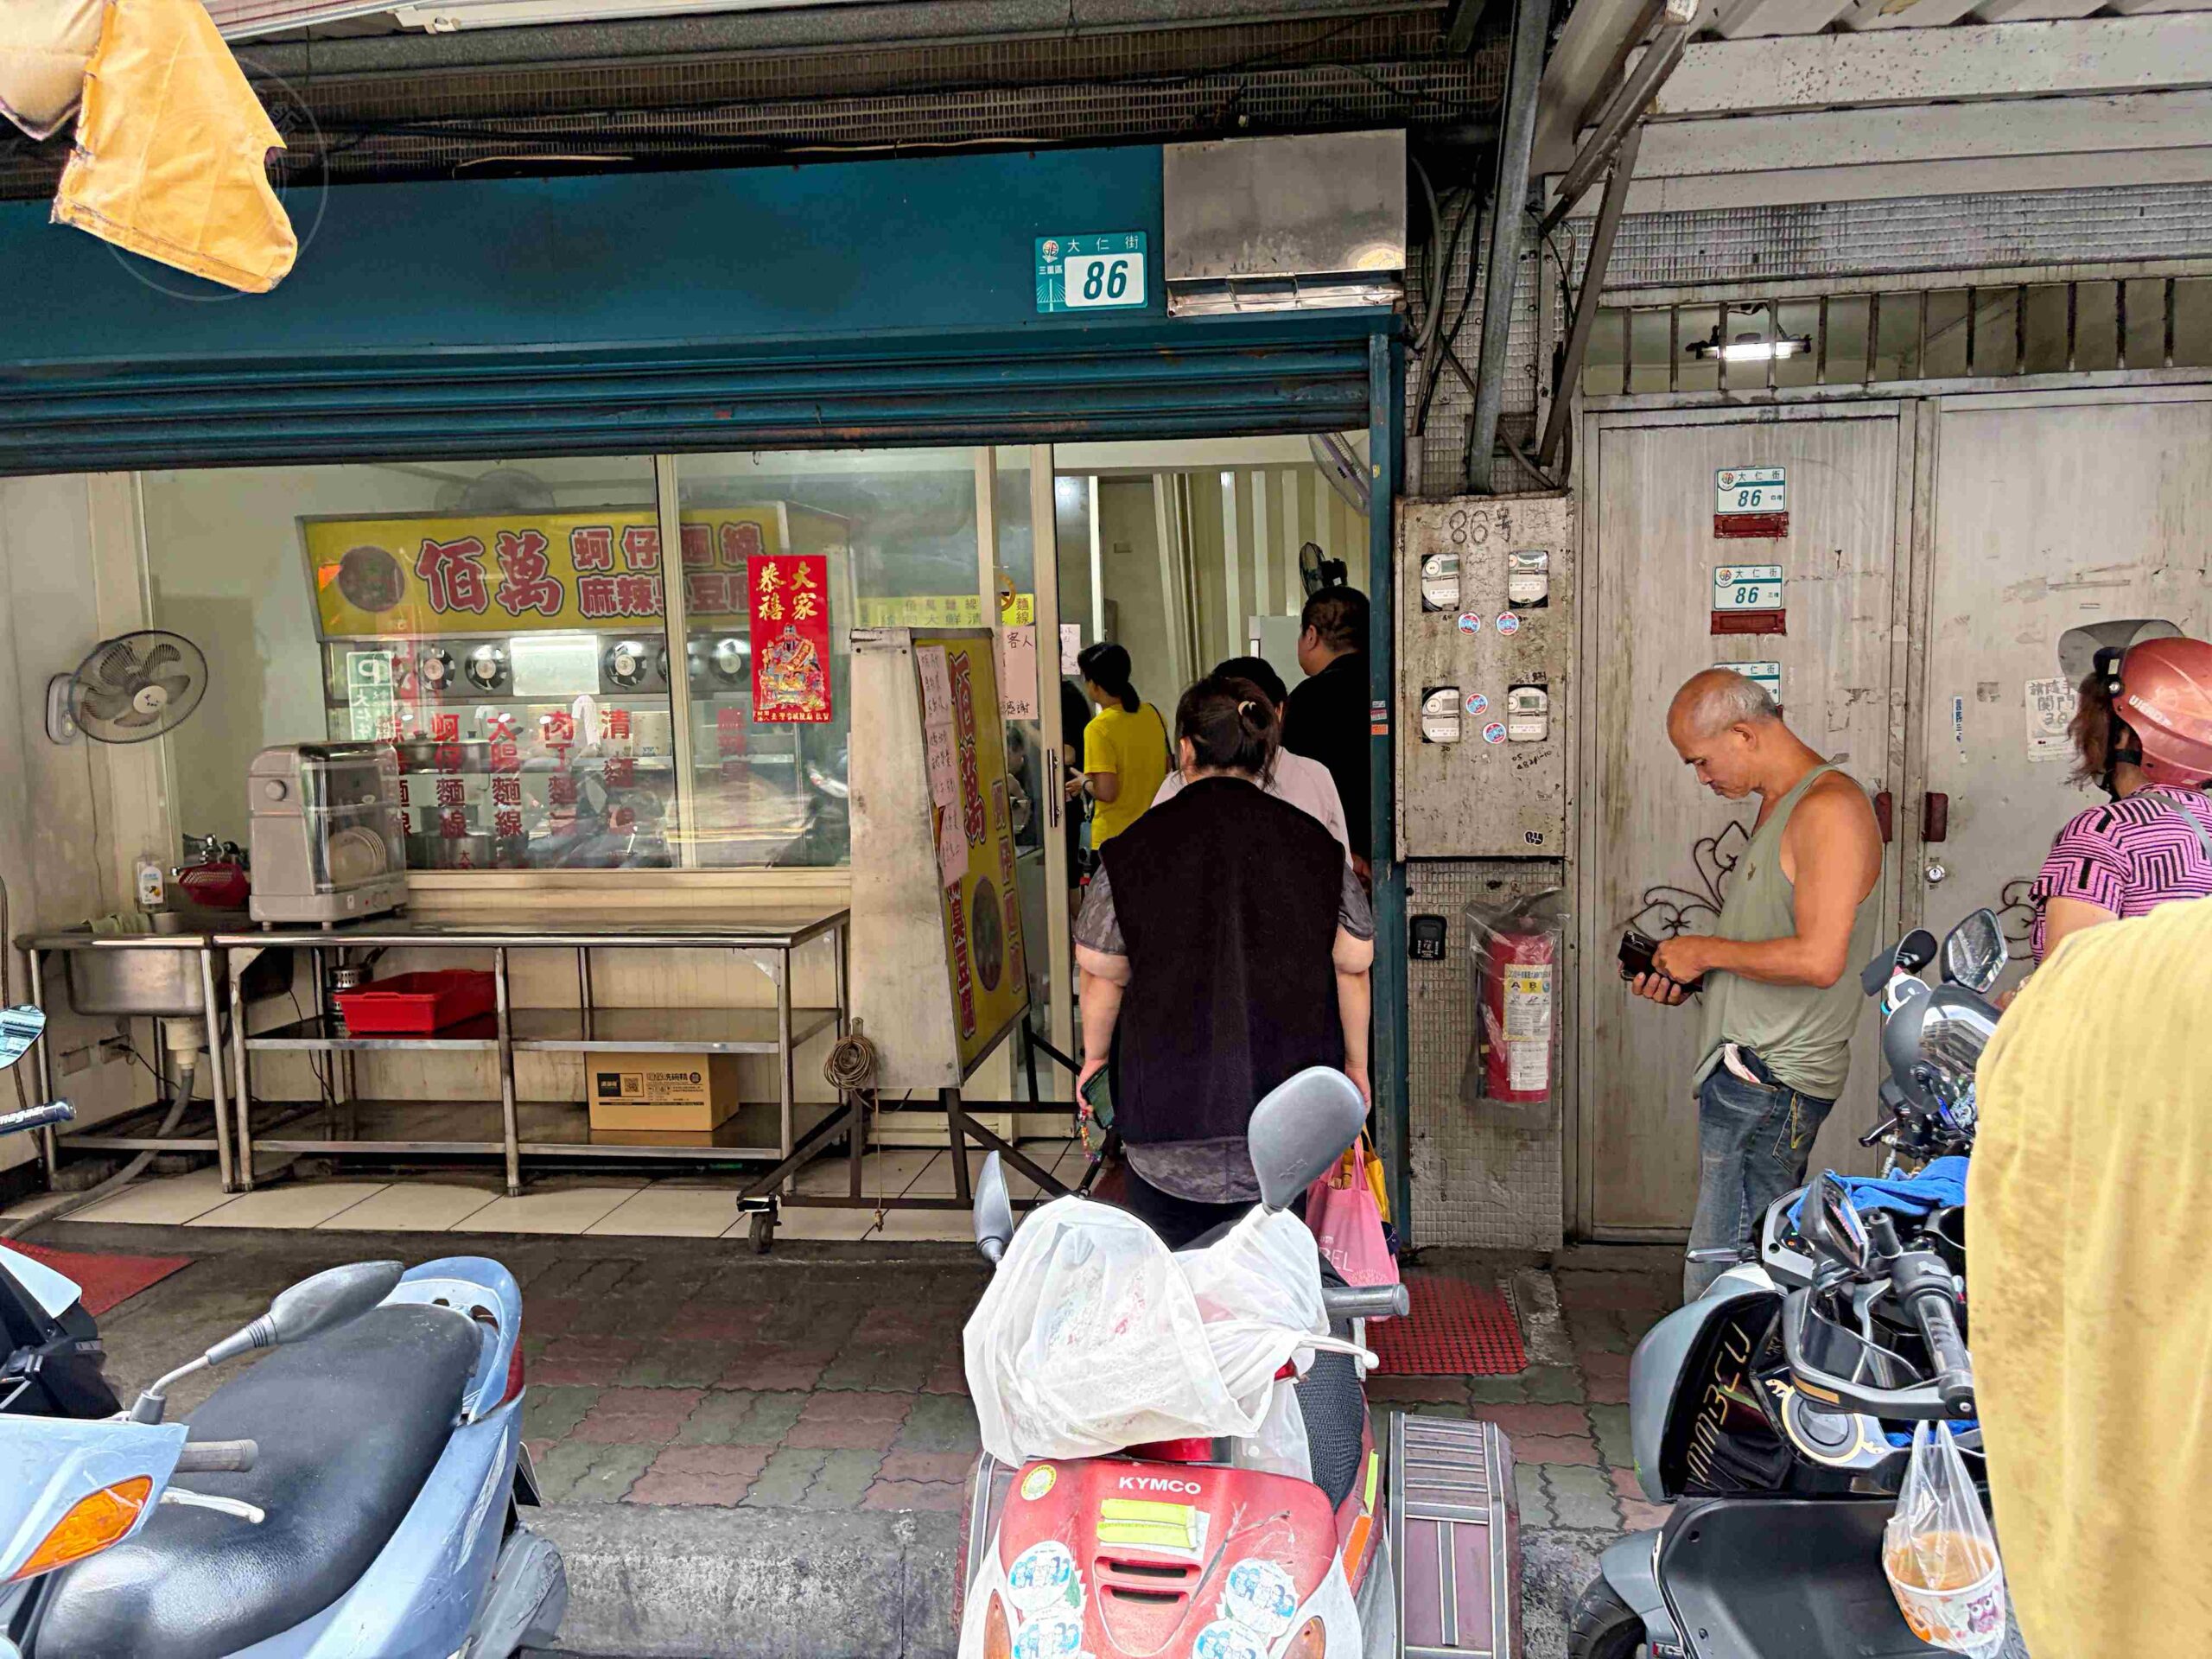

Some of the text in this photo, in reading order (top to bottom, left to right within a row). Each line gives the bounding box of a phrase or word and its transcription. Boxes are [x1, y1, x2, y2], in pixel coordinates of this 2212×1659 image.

[1067, 235, 1138, 253] 大仁街
[1084, 260, 1128, 300] 86
[1738, 471, 1781, 481] 大仁街
[1738, 489, 1763, 507] 86
[415, 531, 563, 616] 佰萬
[1735, 569, 1777, 578] 大仁街
[789, 561, 819, 621] 大家
[1735, 587, 1759, 604] 86
[1007, 632, 1033, 649] 客人
[1119, 1476, 1201, 1495] KYMCO
